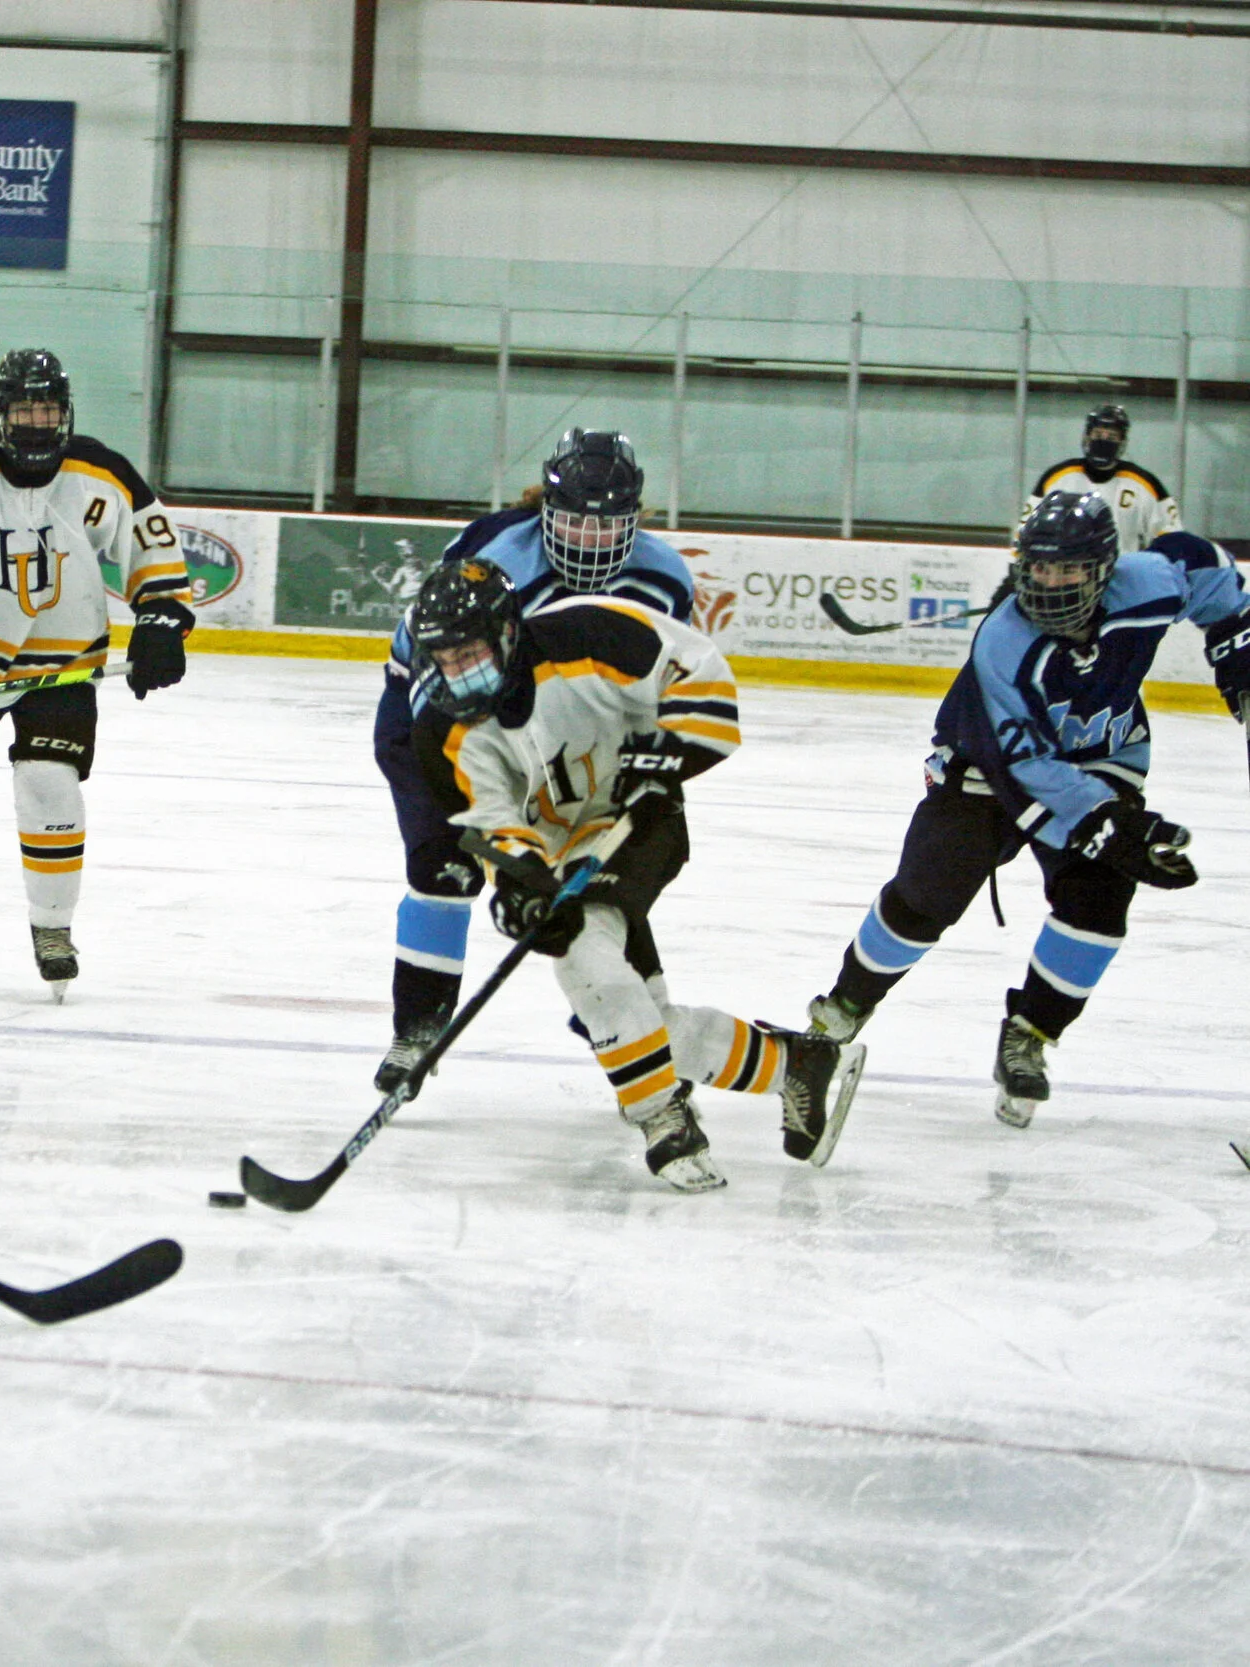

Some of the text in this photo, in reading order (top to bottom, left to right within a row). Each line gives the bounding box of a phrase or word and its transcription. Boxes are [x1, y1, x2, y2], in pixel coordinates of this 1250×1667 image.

[83, 497, 107, 527] A
[132, 514, 176, 552] 19
[744, 571, 898, 609] cypress
[29, 736, 86, 755] CCM
[619, 753, 684, 772] CCM
[45, 822, 77, 832] CCM
